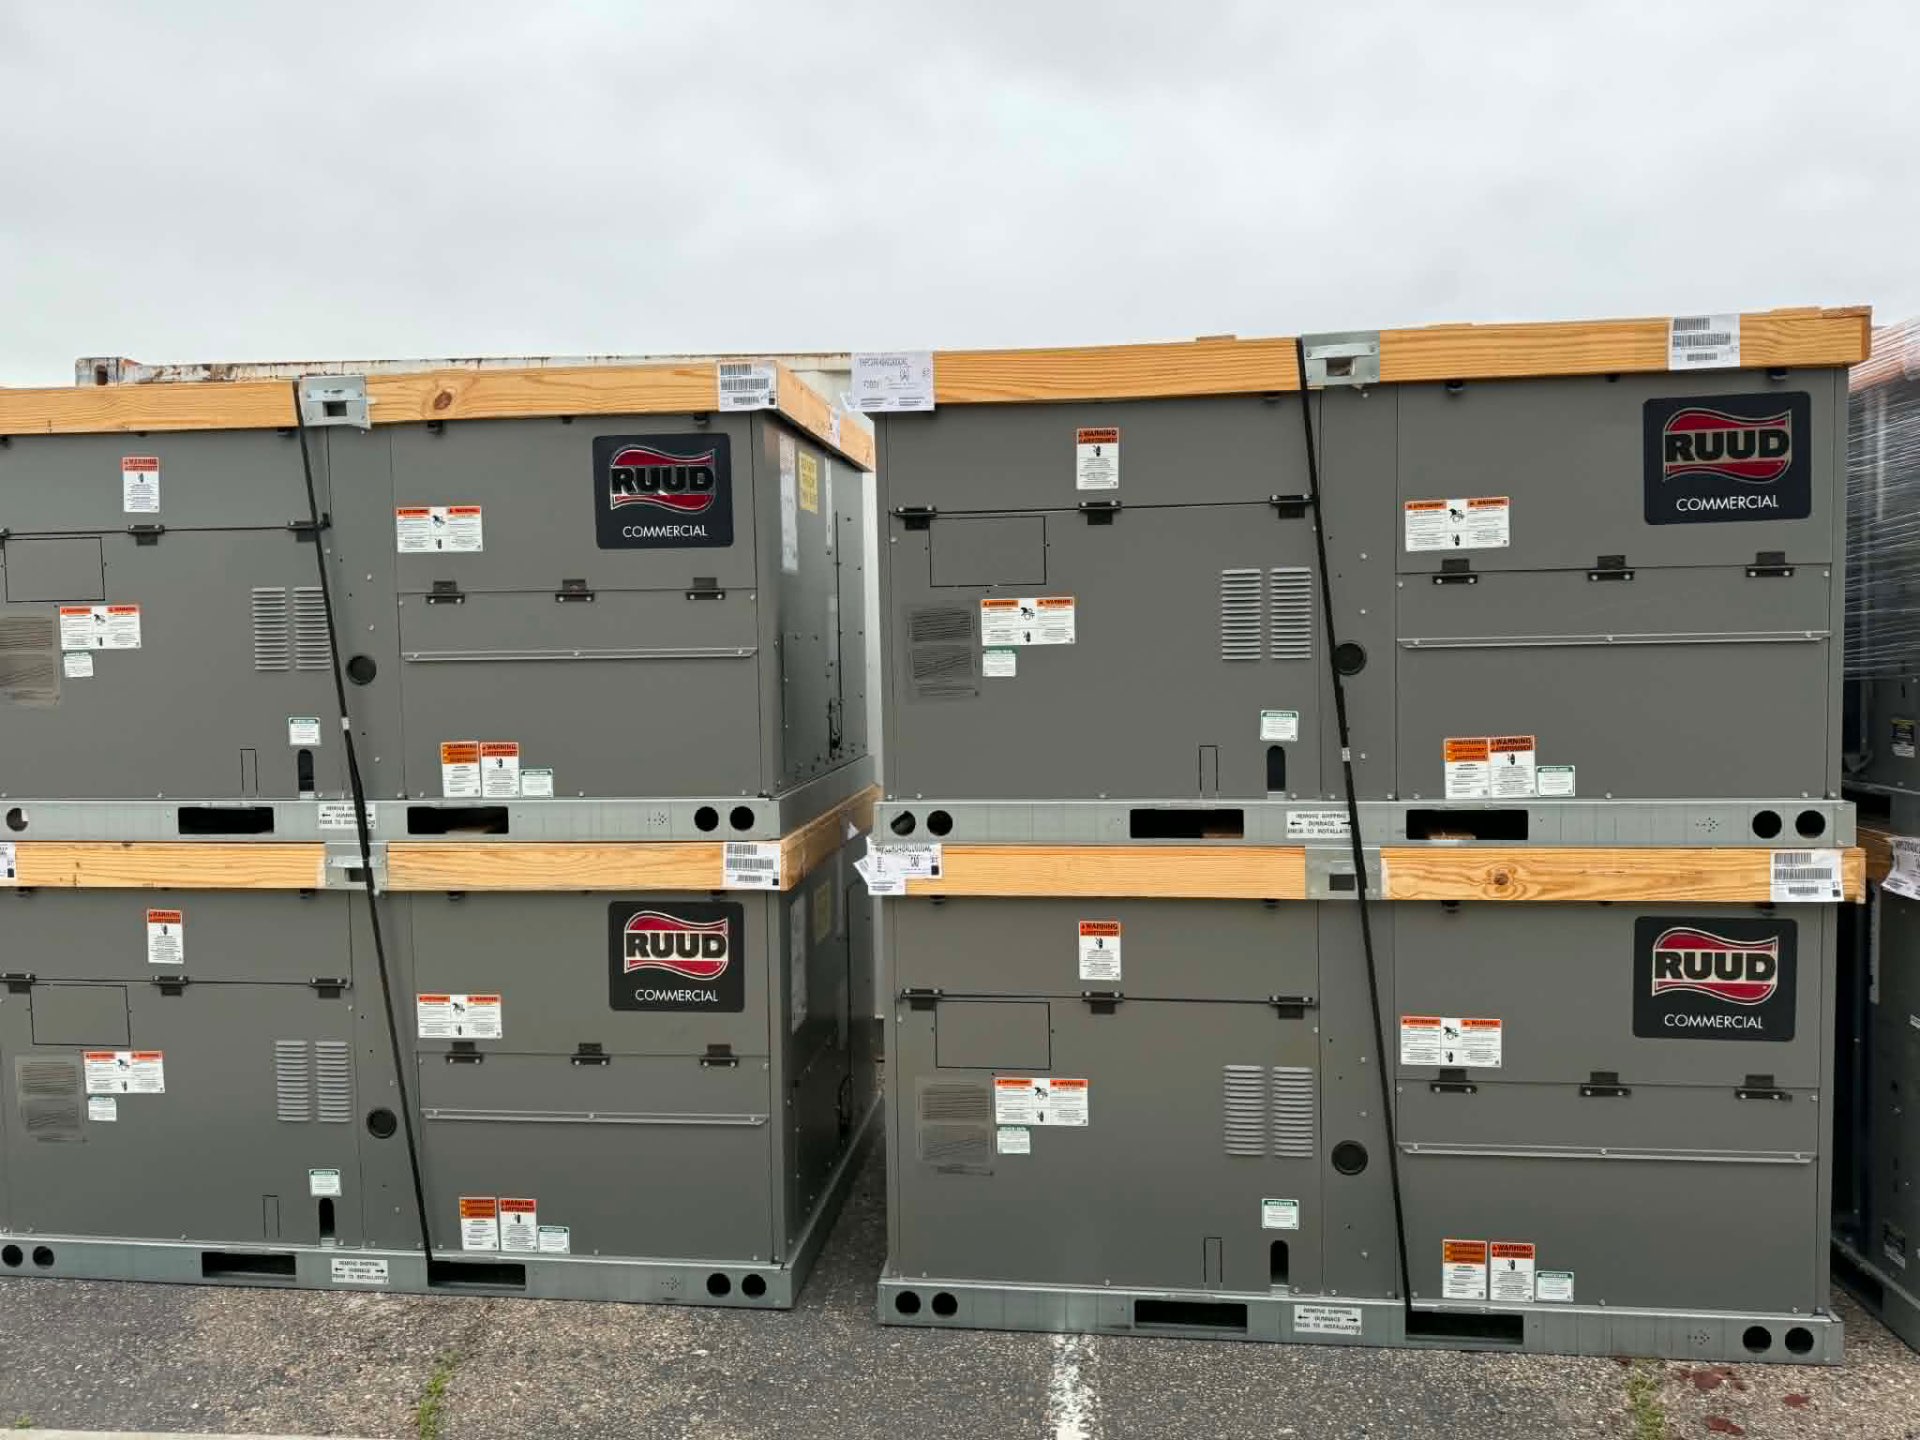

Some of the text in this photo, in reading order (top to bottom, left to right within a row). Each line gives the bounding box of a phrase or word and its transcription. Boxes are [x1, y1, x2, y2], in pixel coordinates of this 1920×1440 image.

[1665, 429, 1790, 463] RUUD
[611, 466, 714, 496] RUUD
[1676, 495, 1779, 512] COMMERCIAL
[622, 525, 708, 539] COMMERCIAL
[1497, 738, 1531, 746] WARNING
[626, 932, 727, 959] RUUD
[1655, 951, 1776, 982] RUUD
[635, 989, 718, 1002] COMMERCIAL
[1664, 1013, 1763, 1029] COMMERCIAL
[1498, 1244, 1532, 1252] WARNING
